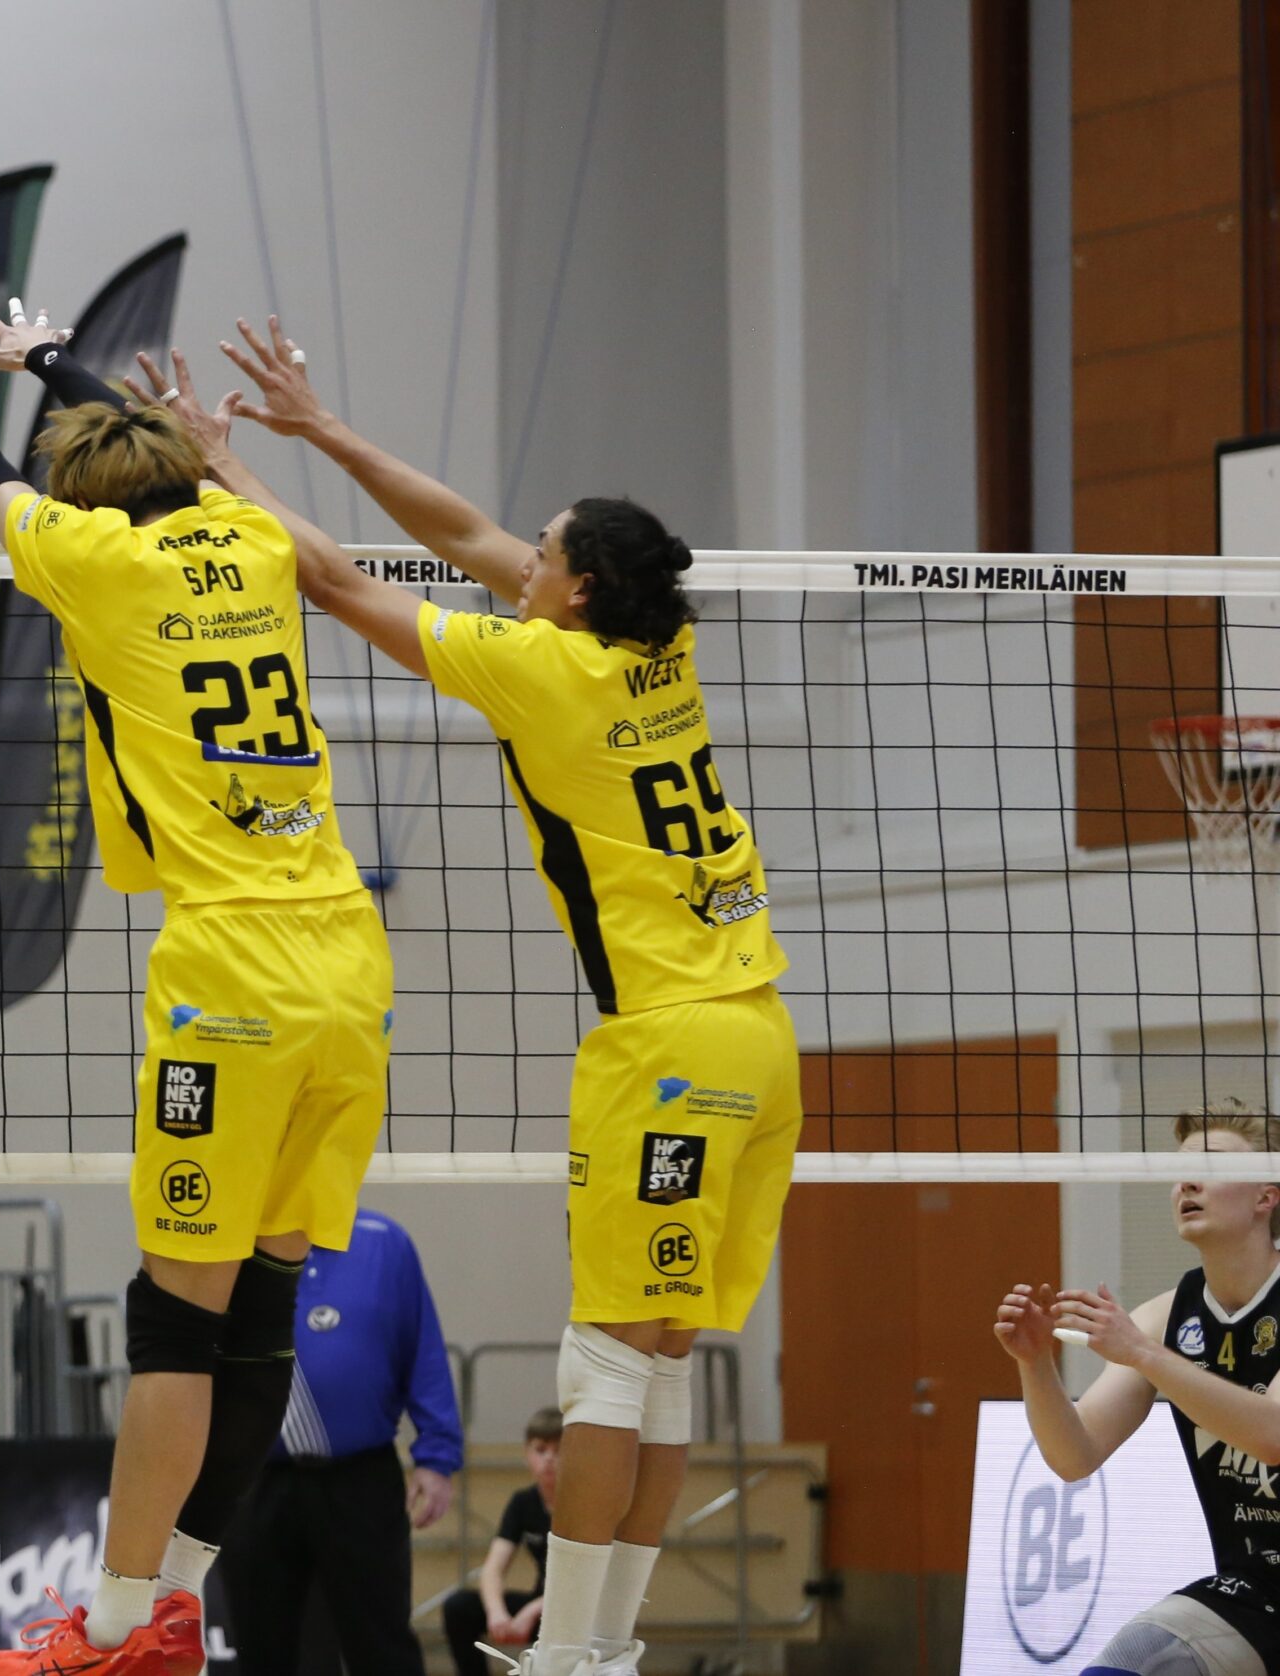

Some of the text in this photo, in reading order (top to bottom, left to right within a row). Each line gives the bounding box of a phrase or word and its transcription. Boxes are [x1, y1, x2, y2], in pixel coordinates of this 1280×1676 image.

[182, 560, 244, 596] SAO
[384, 560, 478, 584] MERIL
[854, 564, 1127, 592] TMI. PASI MERILÄINEN
[198, 604, 275, 627] OJARANNAN
[201, 621, 273, 640] RAKENNUS
[182, 652, 310, 757] 23
[631, 743, 738, 859] 69
[166, 1065, 196, 1085] HO
[165, 1083, 206, 1103] NEY
[164, 1101, 202, 1121] STY
[168, 1172, 203, 1203] BE
[648, 1172, 690, 1190] STY
[156, 1218, 217, 1236] BE GROUP
[657, 1234, 694, 1267] BE
[644, 1281, 704, 1297] BE GROUP
[1217, 1331, 1236, 1372] 4
